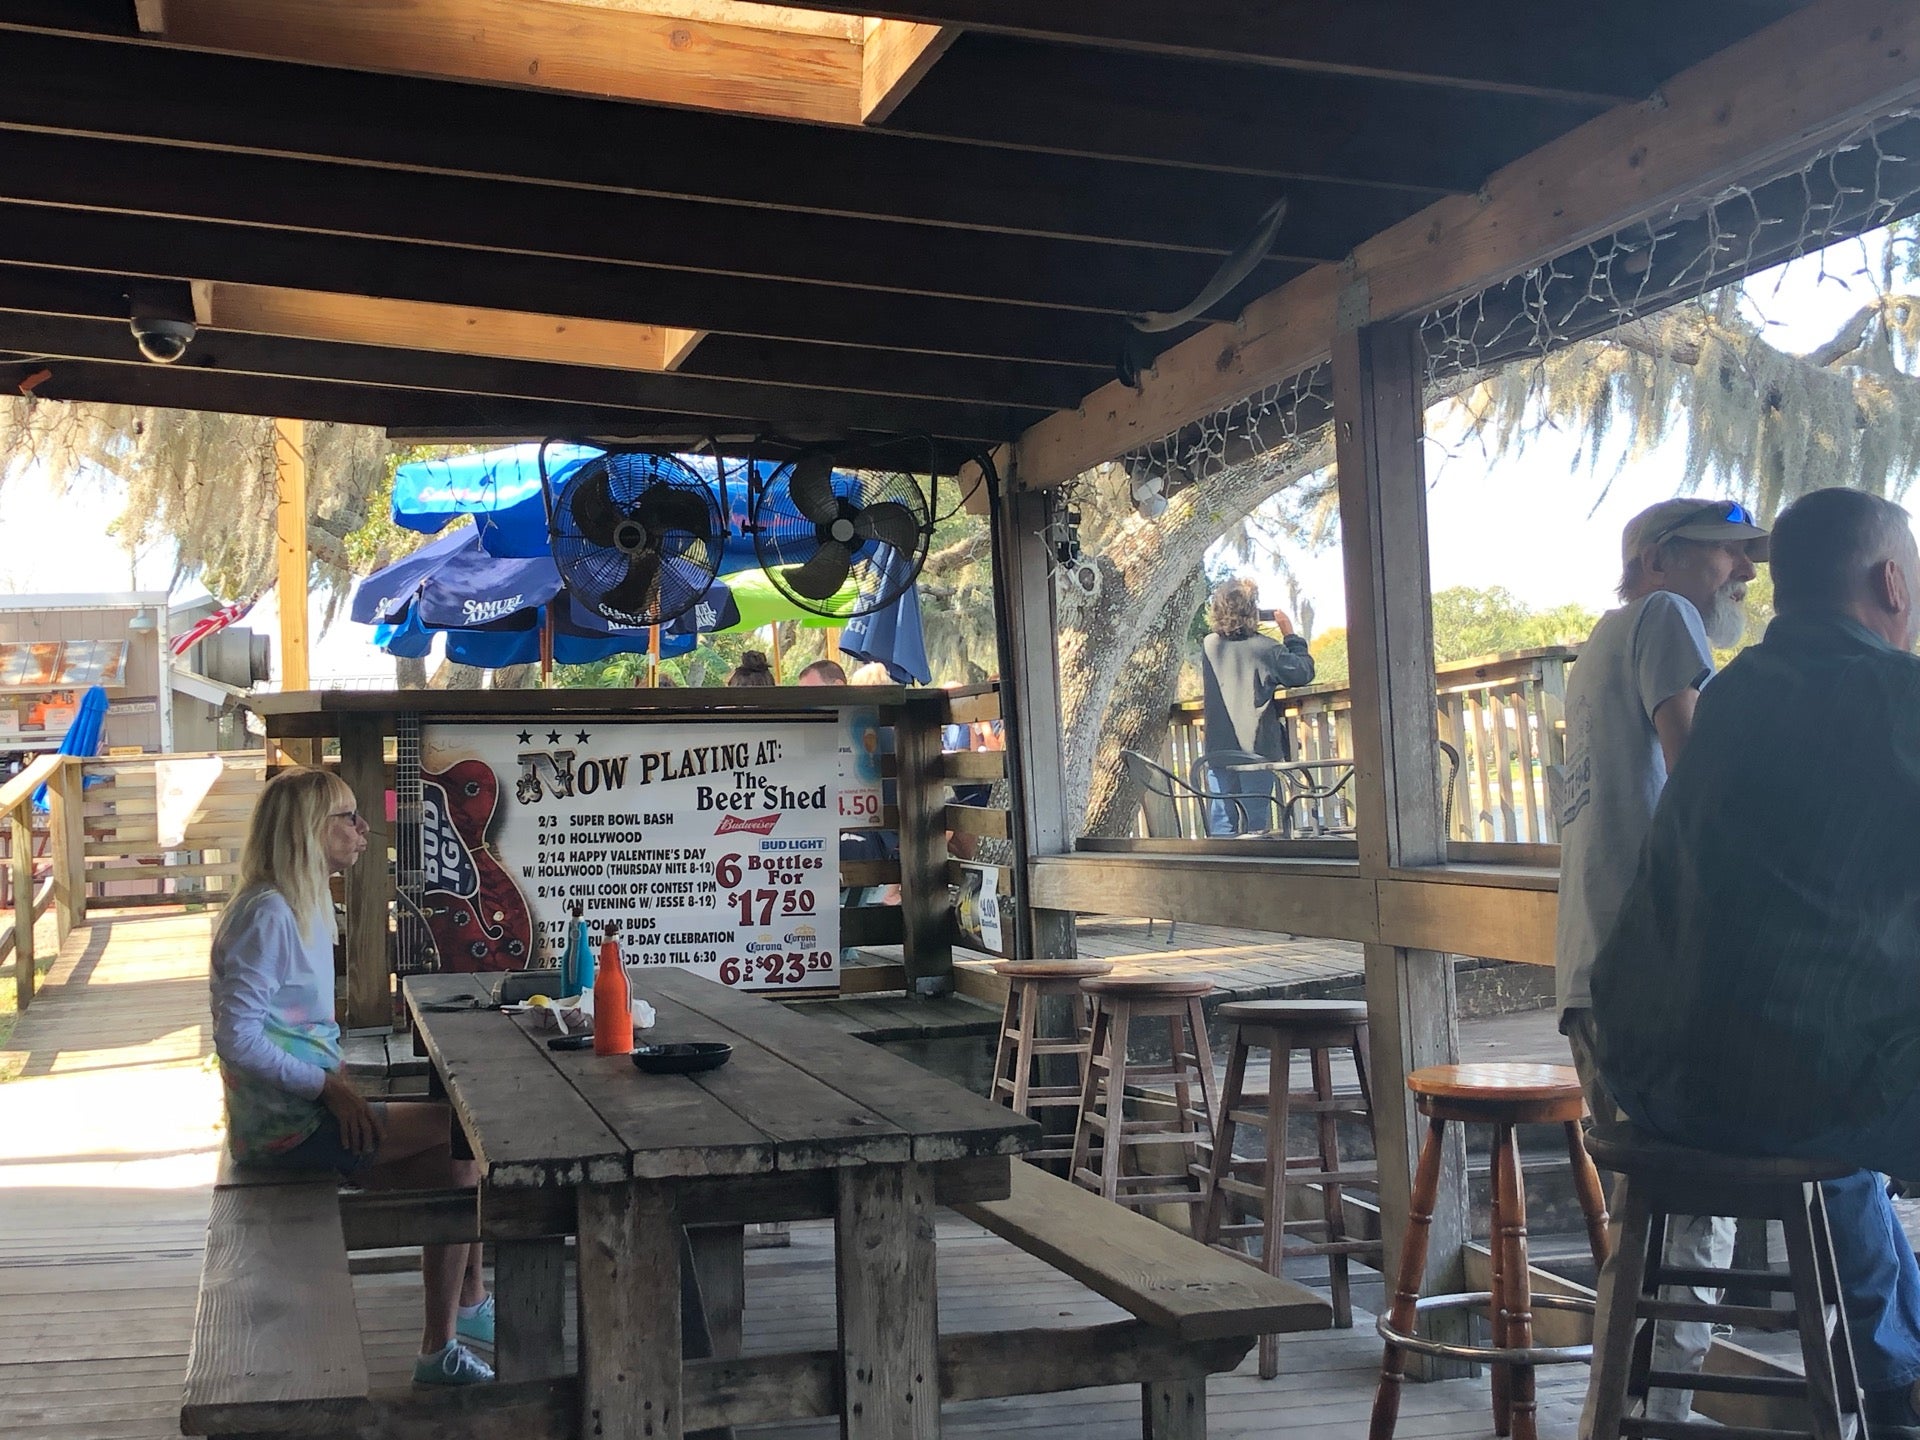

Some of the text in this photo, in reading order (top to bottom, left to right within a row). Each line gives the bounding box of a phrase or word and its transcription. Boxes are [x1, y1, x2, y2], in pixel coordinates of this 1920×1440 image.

[462, 594, 525, 615] SAMUEL
[463, 606, 516, 626] ADAMS
[516, 739, 782, 805] NOW PLAYING AT:
[733, 771, 767, 790] The
[696, 784, 827, 811] Beer Shed
[538, 813, 674, 829] 2/3 SUPER BOWL BASH
[720, 818, 777, 831] Budweiser
[423, 799, 439, 883] BUD
[538, 831, 643, 846] 2/10 HOLLYWOOD
[761, 840, 824, 850] BUD LIGHT
[538, 848, 707, 864] 2/14 HAPPY VALENTINE'S DAY
[522, 861, 716, 879] W/ HOLLYWOOD (THURSDAY NITE 8-12)
[715, 852, 823, 889] 6 Bottles For
[538, 881, 717, 898] 2/16 CHILI COOK OFF CONTEST 1PM
[587, 897, 636, 910] EVENING
[639, 897, 653, 909] W/
[655, 896, 685, 908] JESSE
[688, 894, 717, 910] 8-12)
[538, 921, 565, 934] 2/17
[626, 918, 656, 930] BUDS
[538, 937, 565, 949] 2/18
[627, 934, 660, 946] B-DAY
[664, 931, 735, 944] CELEBRATION
[745, 941, 783, 954] Corona
[784, 933, 817, 945] Corona
[643, 953, 666, 966] 2:30
[670, 952, 691, 964] TILL
[693, 951, 717, 963] 6:30
[719, 957, 741, 986] 6
